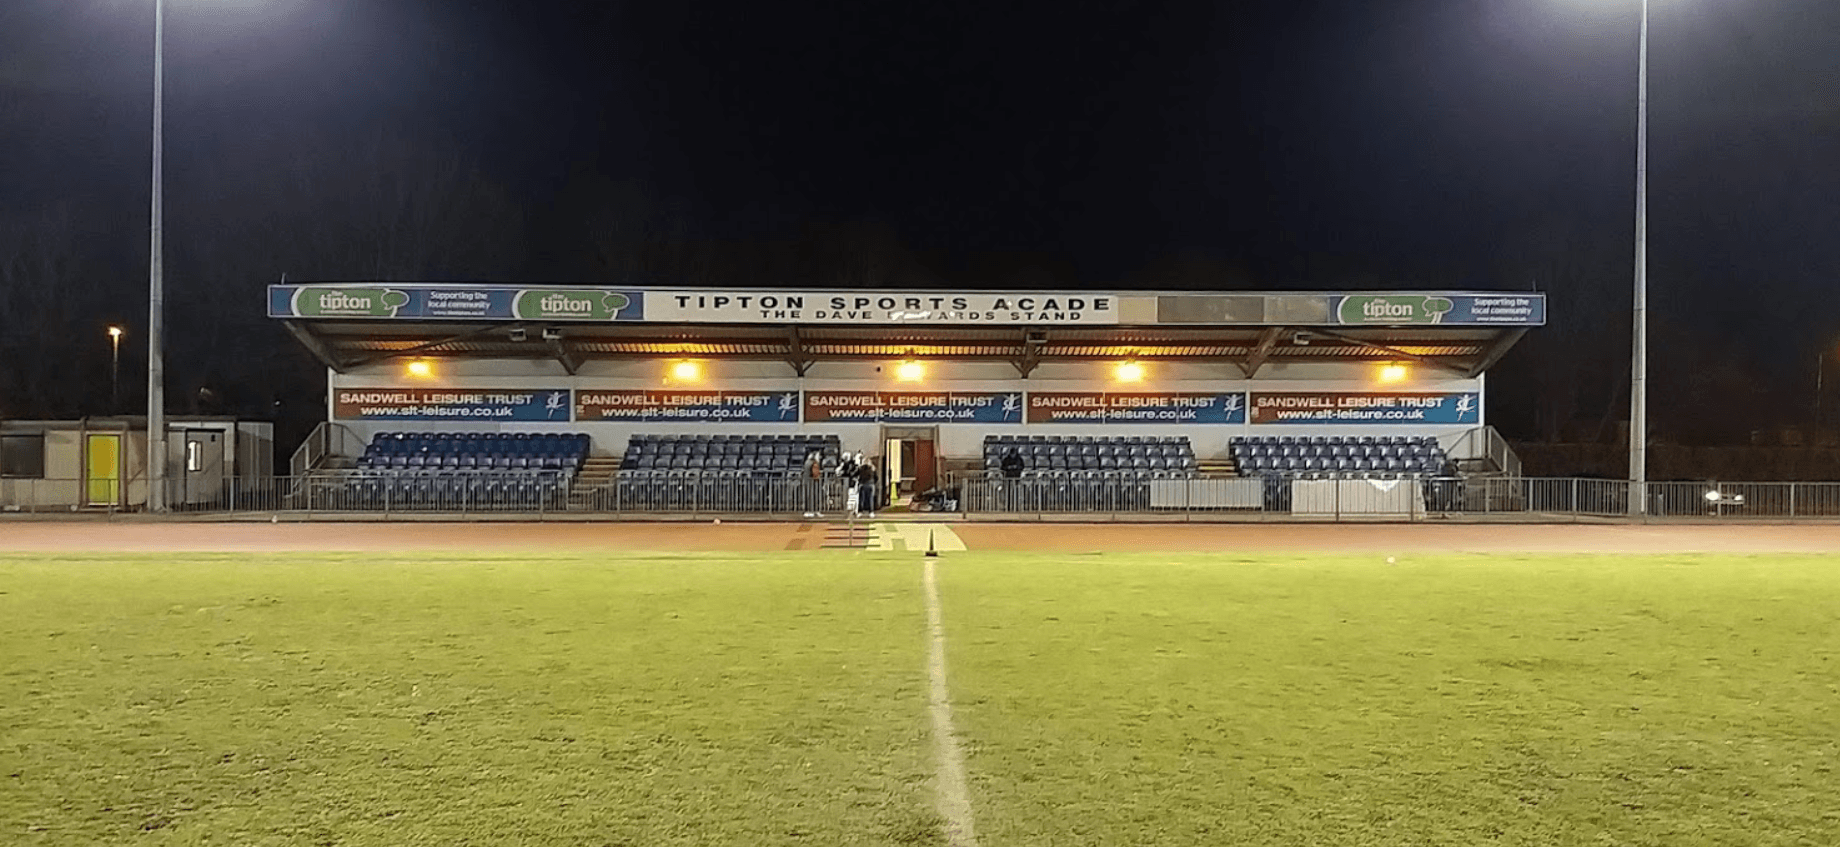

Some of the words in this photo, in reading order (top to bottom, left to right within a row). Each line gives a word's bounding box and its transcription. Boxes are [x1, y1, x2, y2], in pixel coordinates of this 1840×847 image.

[430, 290, 473, 301] Supporting
[474, 291, 488, 300] the
[319, 294, 371, 310] tipton
[447, 301, 492, 310] community
[540, 297, 592, 313] tipton
[675, 296, 803, 309] TIPTON
[830, 297, 968, 310] SPORTS
[993, 298, 1110, 310] ACADE
[1474, 298, 1516, 307] Supporting
[1516, 298, 1530, 306] the
[1363, 301, 1413, 317] tipton
[1490, 307, 1532, 316] community
[760, 310, 801, 319] THE
[816, 311, 872, 319] DAVE
[1010, 311, 1081, 320] STAND
[340, 393, 419, 404] SANDWELL
[423, 394, 483, 404] LEISURE
[487, 395, 533, 405] TRUST
[581, 395, 660, 405] SANDWELL
[663, 395, 722, 405] LEISURE
[725, 396, 771, 406] TRUST
[809, 396, 886, 406] SANDWELL
[889, 396, 946, 406] LEISURE
[951, 397, 995, 407] TRUST
[1032, 397, 1108, 407] SANDWELL
[1110, 397, 1168, 407] LEISURE
[1173, 397, 1216, 407] TRUST
[1257, 397, 1334, 408] SANDWELL
[1337, 397, 1396, 407] LEISURE
[1399, 397, 1444, 407] TRUST
[361, 406, 514, 417] www.slt-leisure.co.uk
[602, 407, 751, 418] www.slt-leisure.co.uk
[829, 407, 975, 418] www.slt-leisure.co.uk
[1052, 408, 1197, 420] www.slt-leisure.co.uk
[1277, 409, 1424, 420] www.slt-leisure.co.uk
